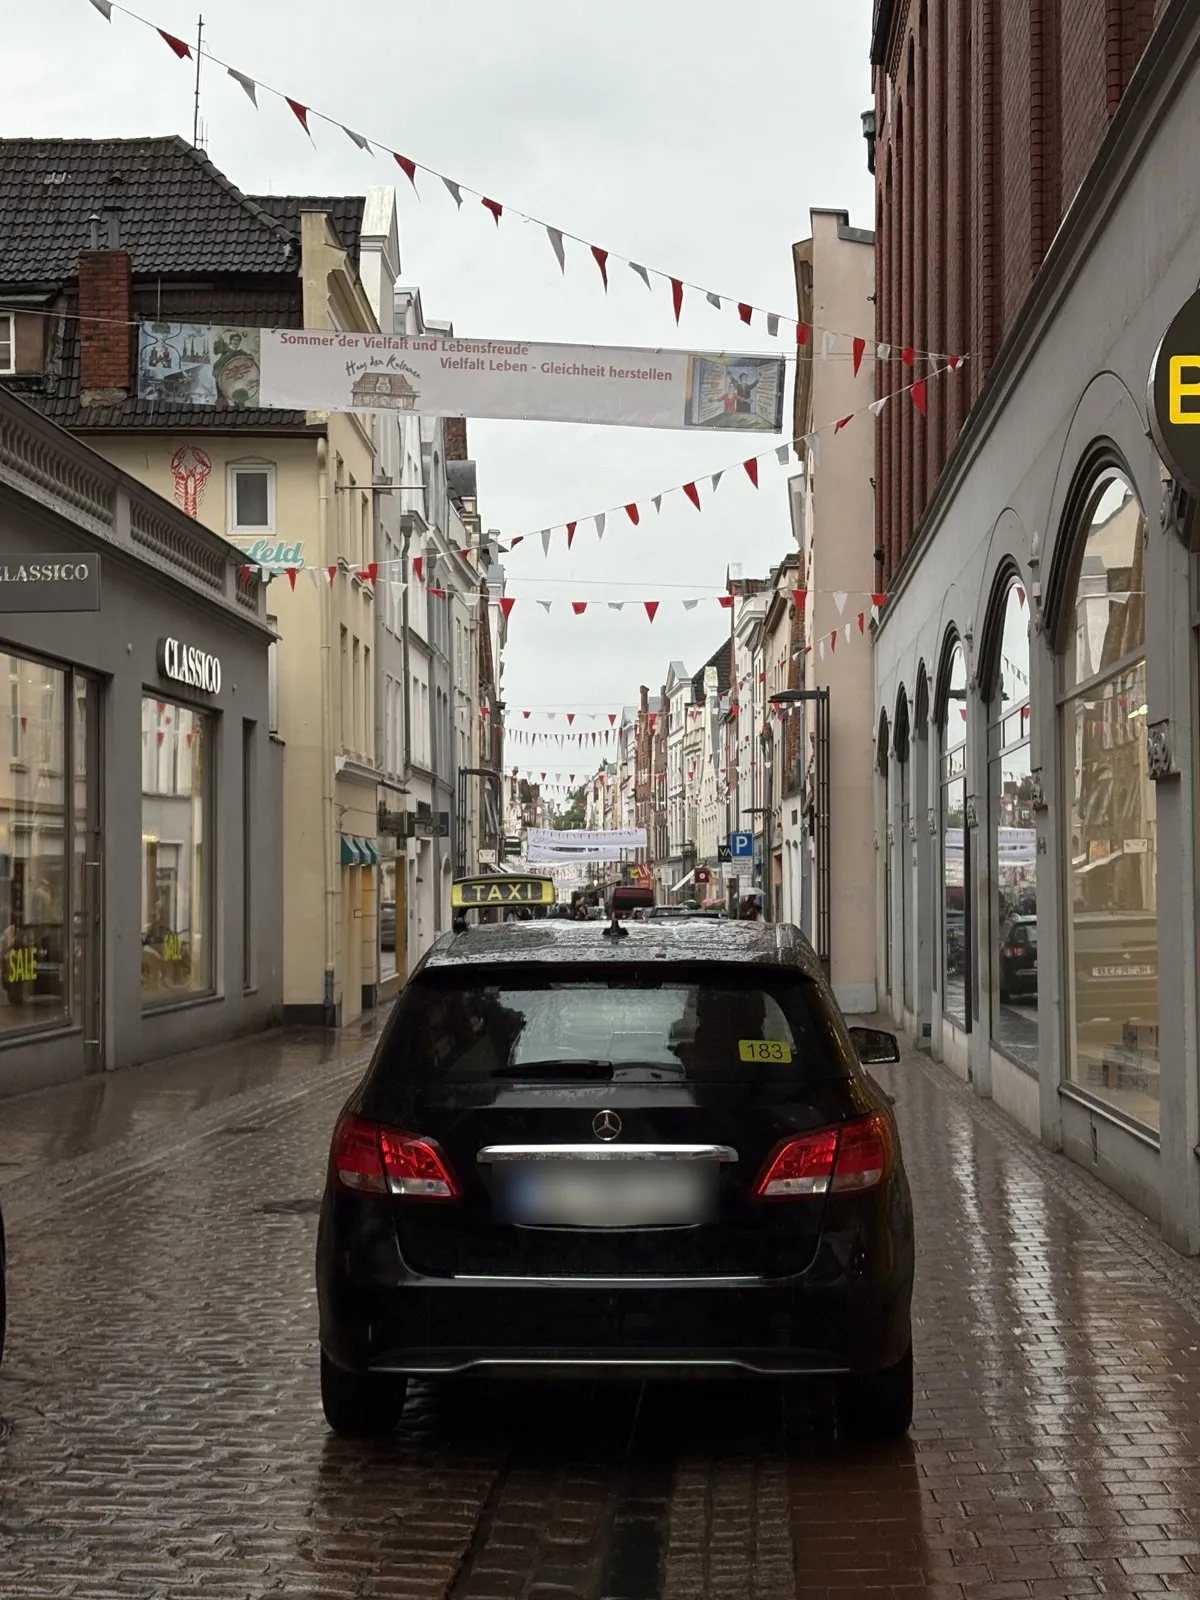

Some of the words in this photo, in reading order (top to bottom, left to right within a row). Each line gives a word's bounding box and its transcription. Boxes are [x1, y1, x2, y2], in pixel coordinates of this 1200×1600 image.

[280, 332, 334, 346] Sommer
[338, 335, 360, 348] der
[363, 336, 408, 350] Vielfalt
[412, 339, 437, 351] und
[441, 340, 528, 355] Lebensfreude
[369, 355, 384, 367] der
[440, 357, 485, 371] Vielfalt
[489, 360, 528, 371] Leben
[541, 362, 605, 377] Gleichheit
[609, 366, 673, 380] herstellen
[240, 539, 305, 571] feld
[0, 564, 89, 581] LASSICO
[165, 637, 222, 694] CLASSICO
[736, 836, 748, 854] P
[472, 884, 532, 901] TAXI
[8, 947, 37, 983] SALE
[747, 1043, 783, 1060] 183
